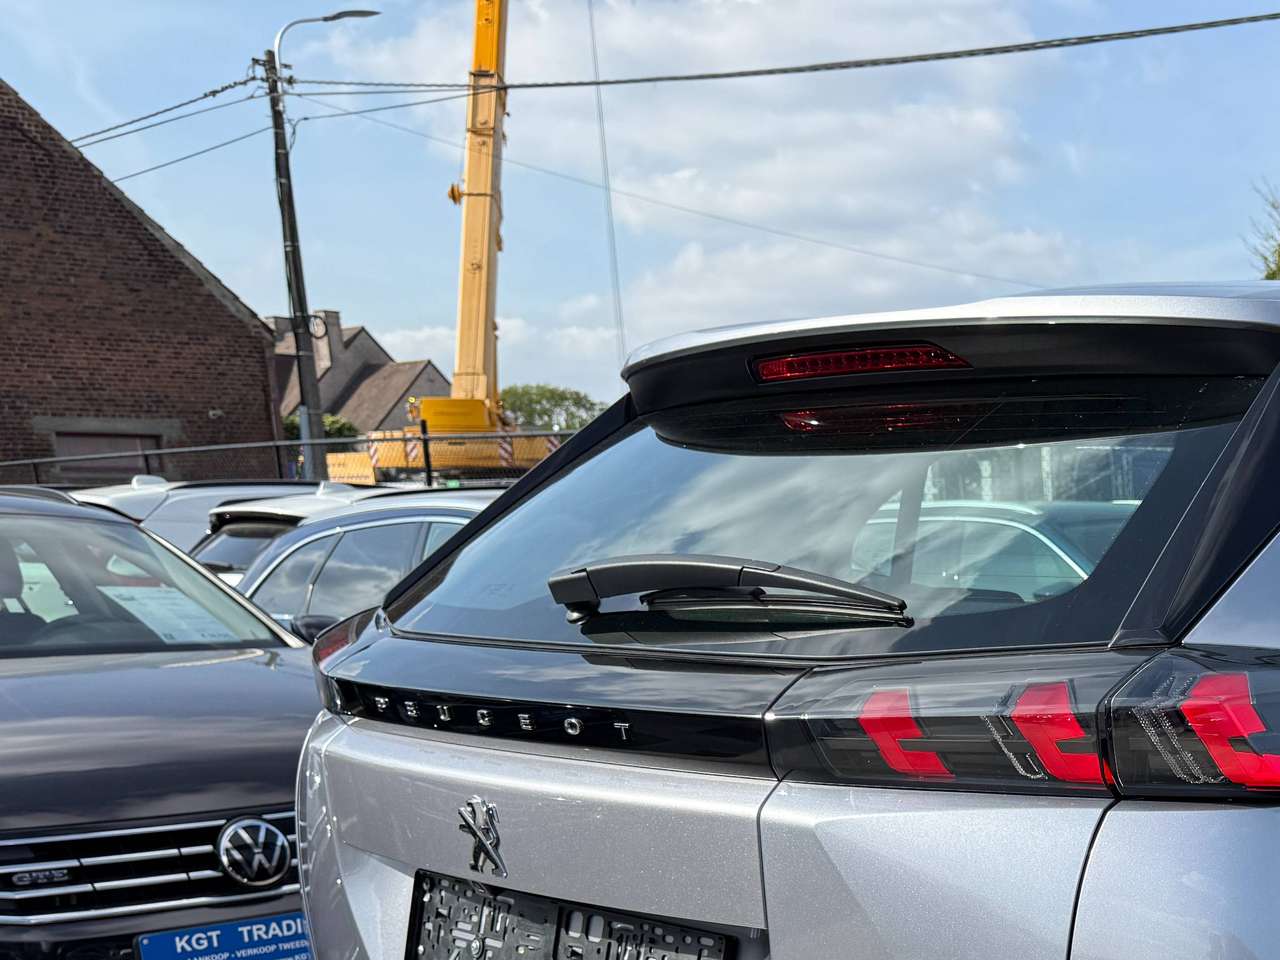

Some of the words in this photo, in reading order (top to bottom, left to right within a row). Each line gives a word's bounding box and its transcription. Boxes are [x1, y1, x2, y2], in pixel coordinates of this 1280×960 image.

[374, 696, 632, 742] PEUGEOT
[174, 930, 222, 954] KGT
[238, 918, 307, 943] TRADI
[236, 945, 277, 958] VERKOOP
